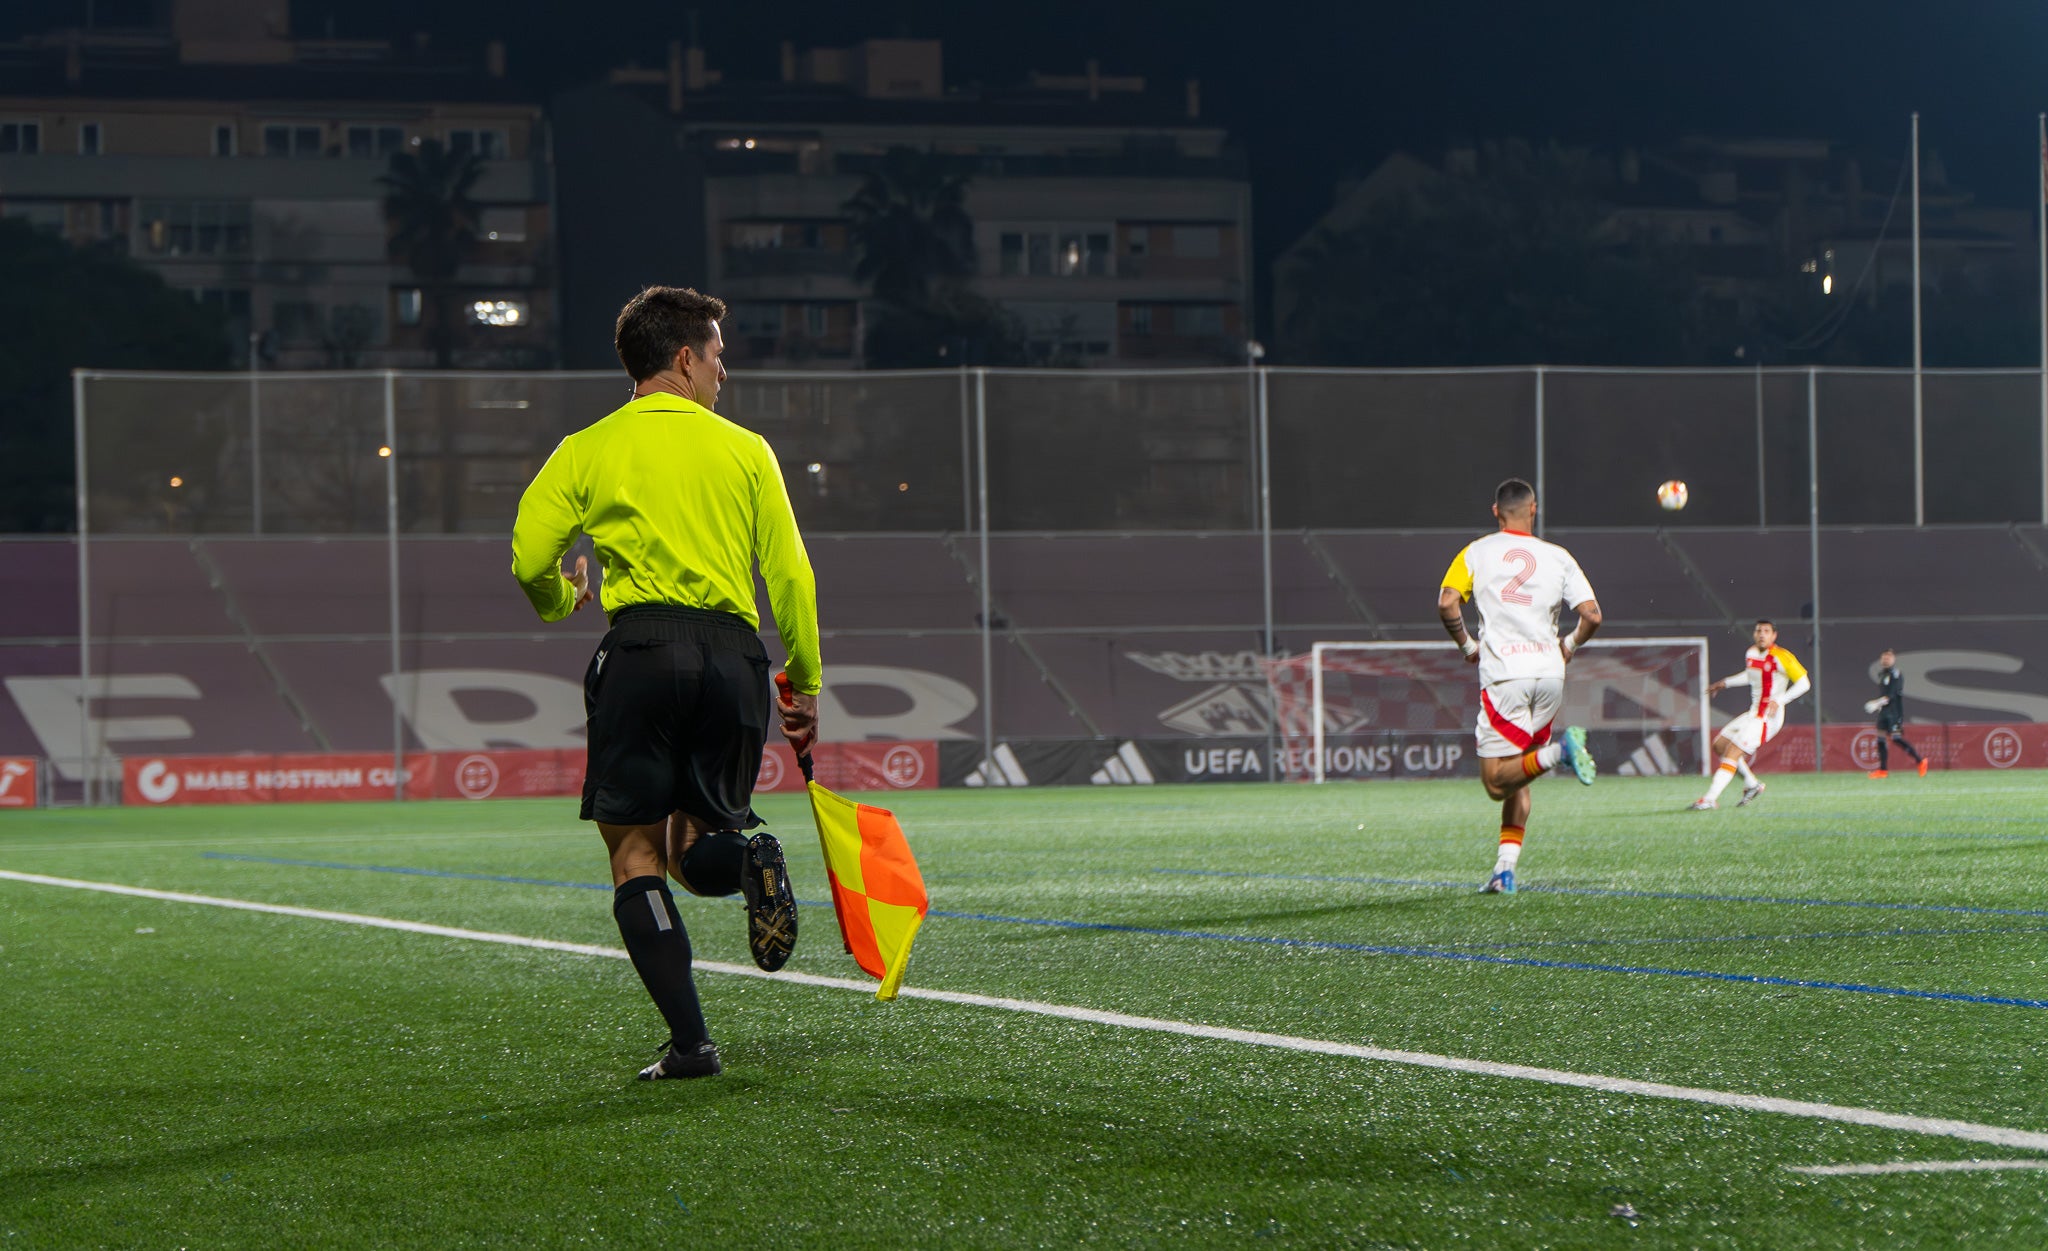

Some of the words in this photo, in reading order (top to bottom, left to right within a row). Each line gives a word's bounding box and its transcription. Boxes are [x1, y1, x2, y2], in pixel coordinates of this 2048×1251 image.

[1501, 548, 1537, 606] 2
[1184, 748, 1262, 774] UEFA
[1403, 744, 1463, 772] CUP
[185, 771, 249, 791] MARE
[254, 768, 362, 789] NOSTRUM
